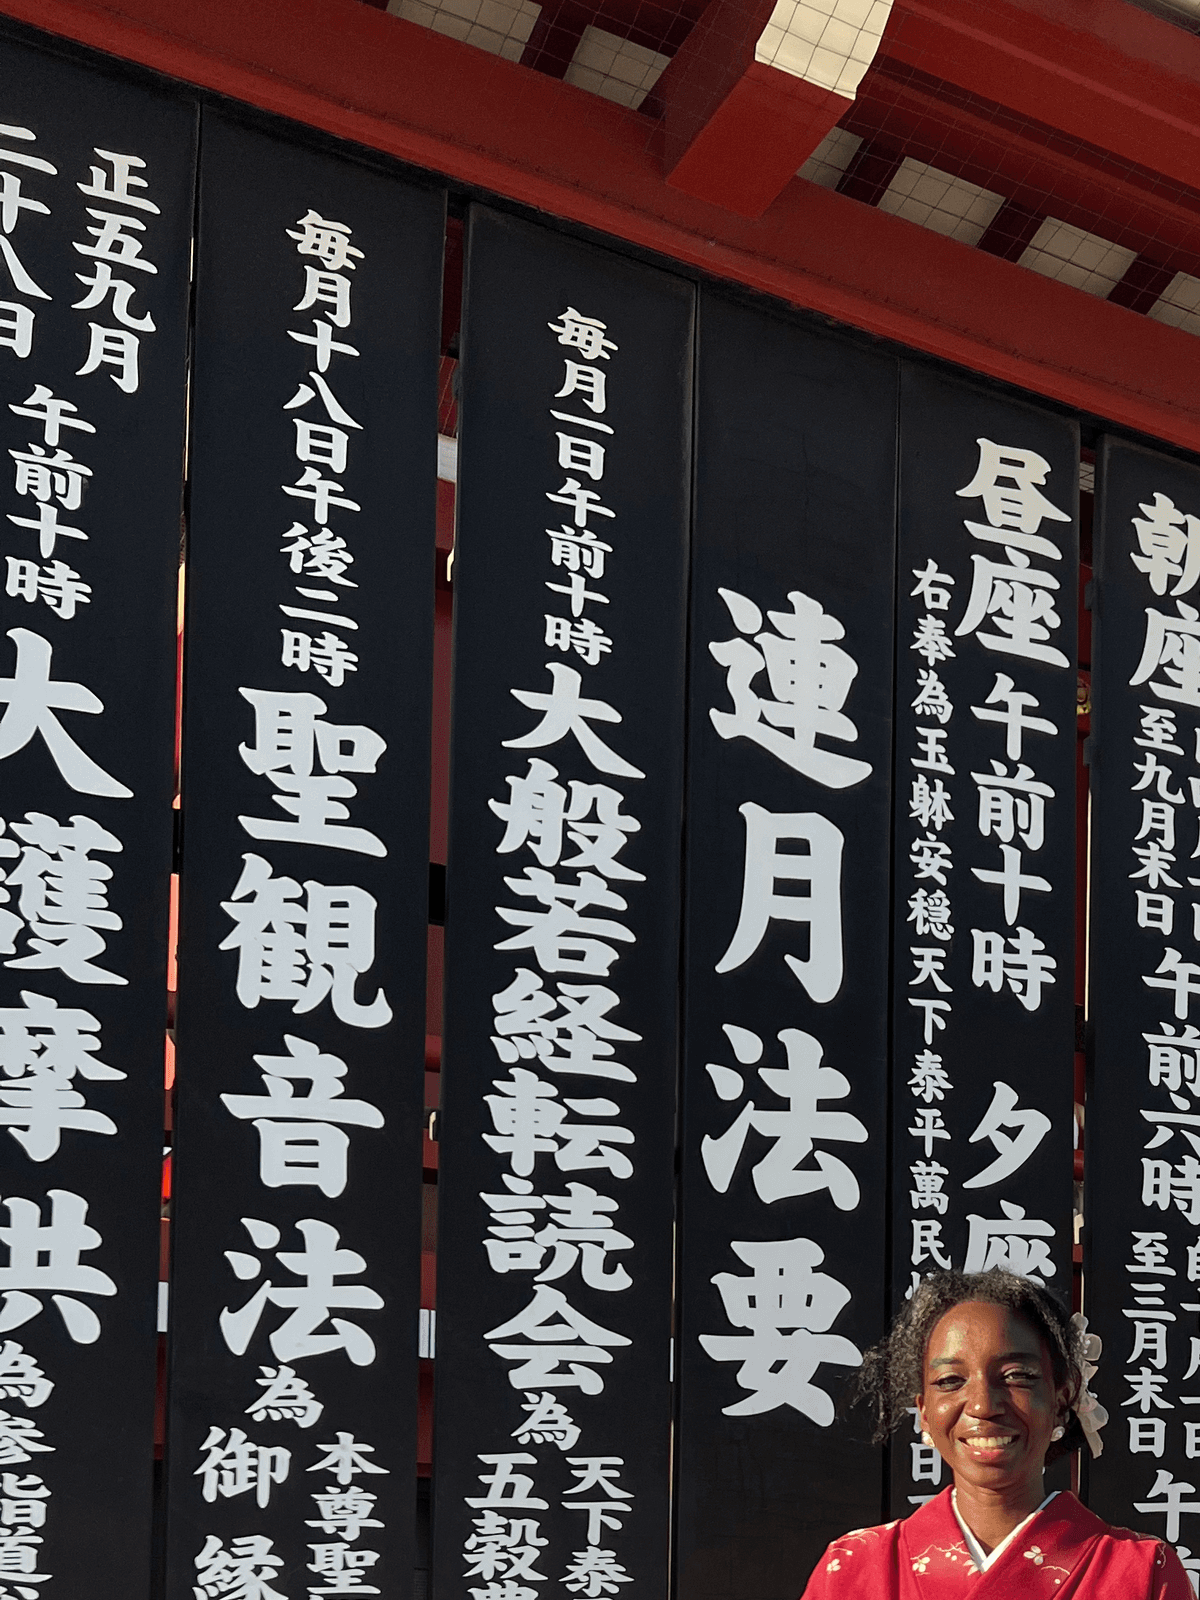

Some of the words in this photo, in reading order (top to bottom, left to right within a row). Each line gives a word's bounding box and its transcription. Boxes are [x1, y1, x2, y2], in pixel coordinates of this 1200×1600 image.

[71, 148, 160, 393] 正五九月
[5, 384, 96, 619] 午前十時
[279, 209, 365, 686] 毎月十八日午後二時
[544, 307, 618, 665] 毎月一日午前十時
[955, 438, 1071, 668] 昼座
[971, 673, 1058, 1011] 午前十時
[1129, 705, 1185, 935] 至九月末日
[219, 687, 392, 1366] 聖観音法
[480, 662, 646, 1395] 大般若経転読会
[699, 588, 872, 1426] 連月法要
[245, 1365, 324, 1428] 為
[511, 1392, 581, 1450] 為
[1121, 1232, 1176, 1457] 至三月末日
